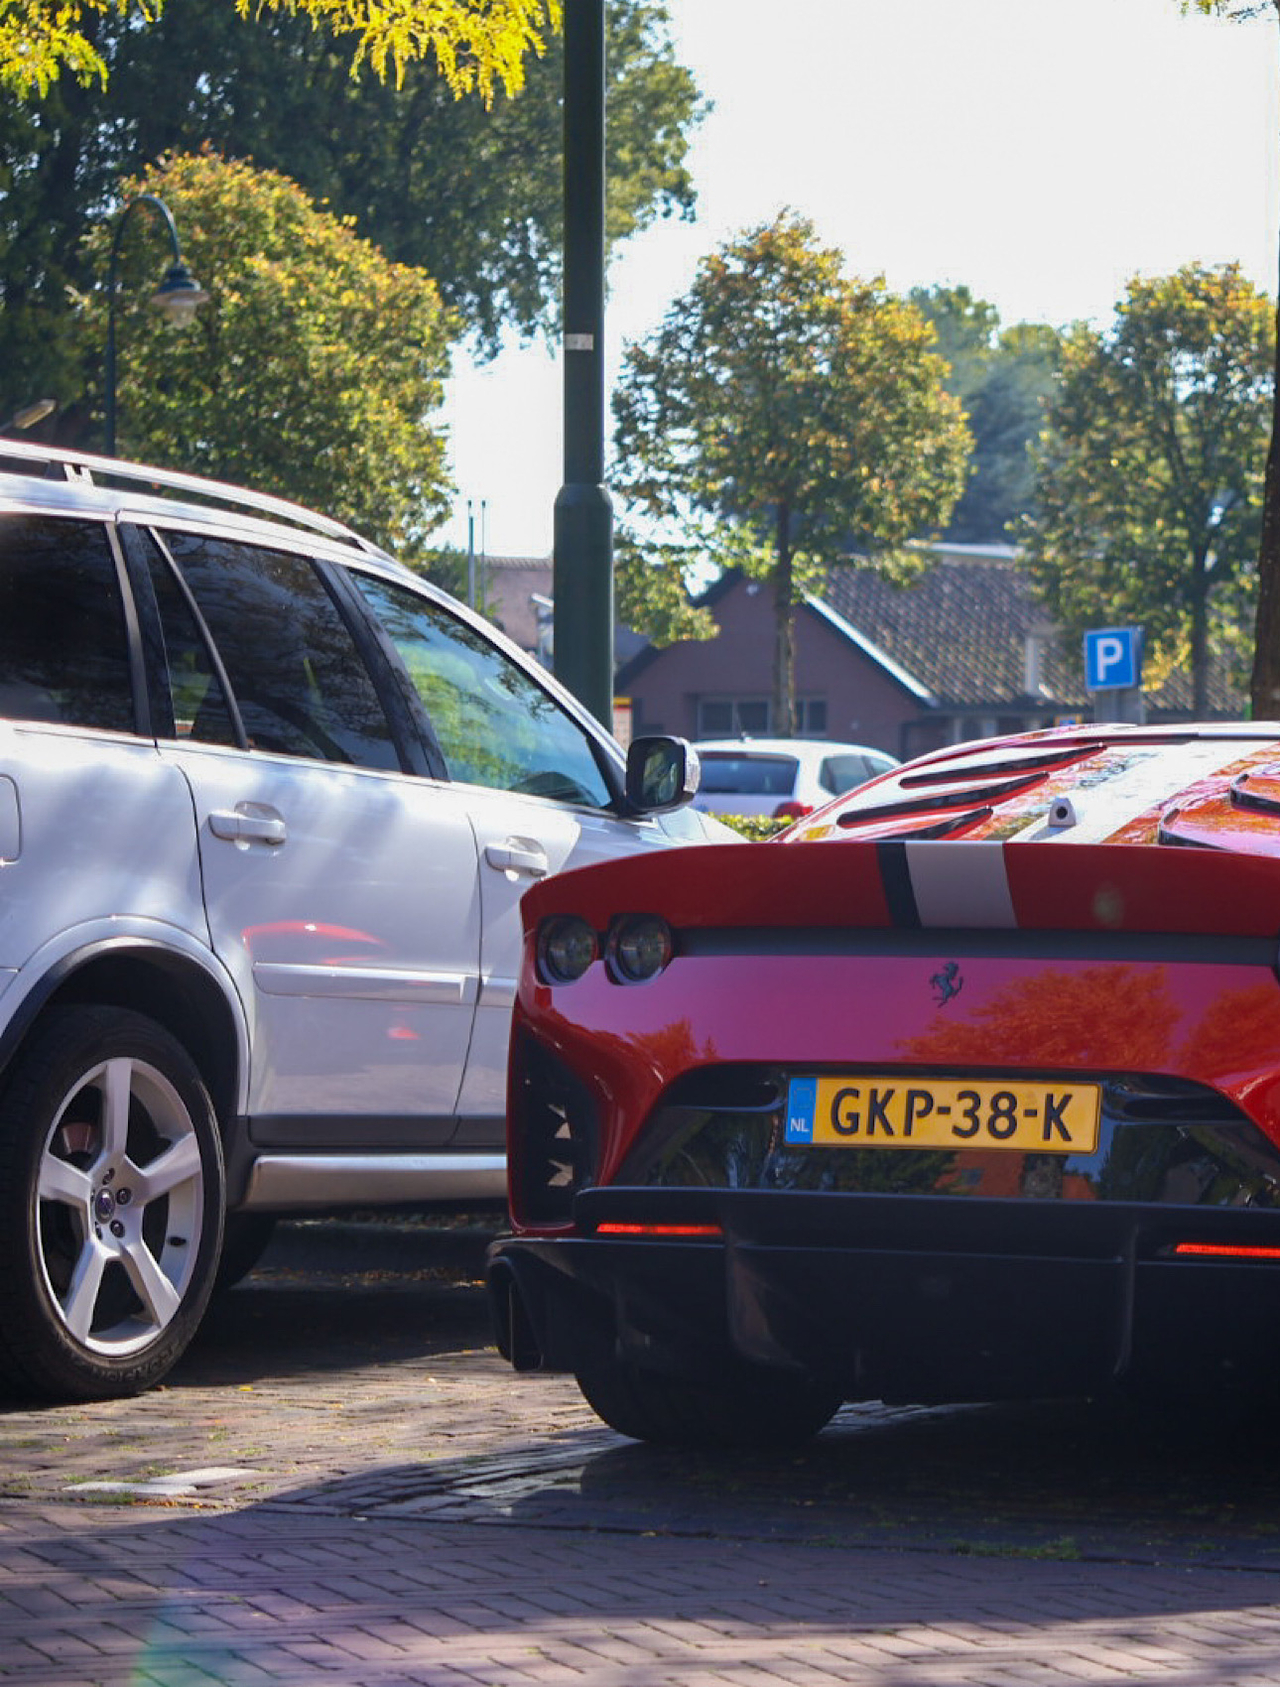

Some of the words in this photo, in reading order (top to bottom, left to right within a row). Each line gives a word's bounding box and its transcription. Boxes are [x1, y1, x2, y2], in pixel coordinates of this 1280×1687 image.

[1096, 638, 1123, 681] P
[790, 1118, 809, 1132] NL
[830, 1087, 1072, 1142] GKP-38-K
